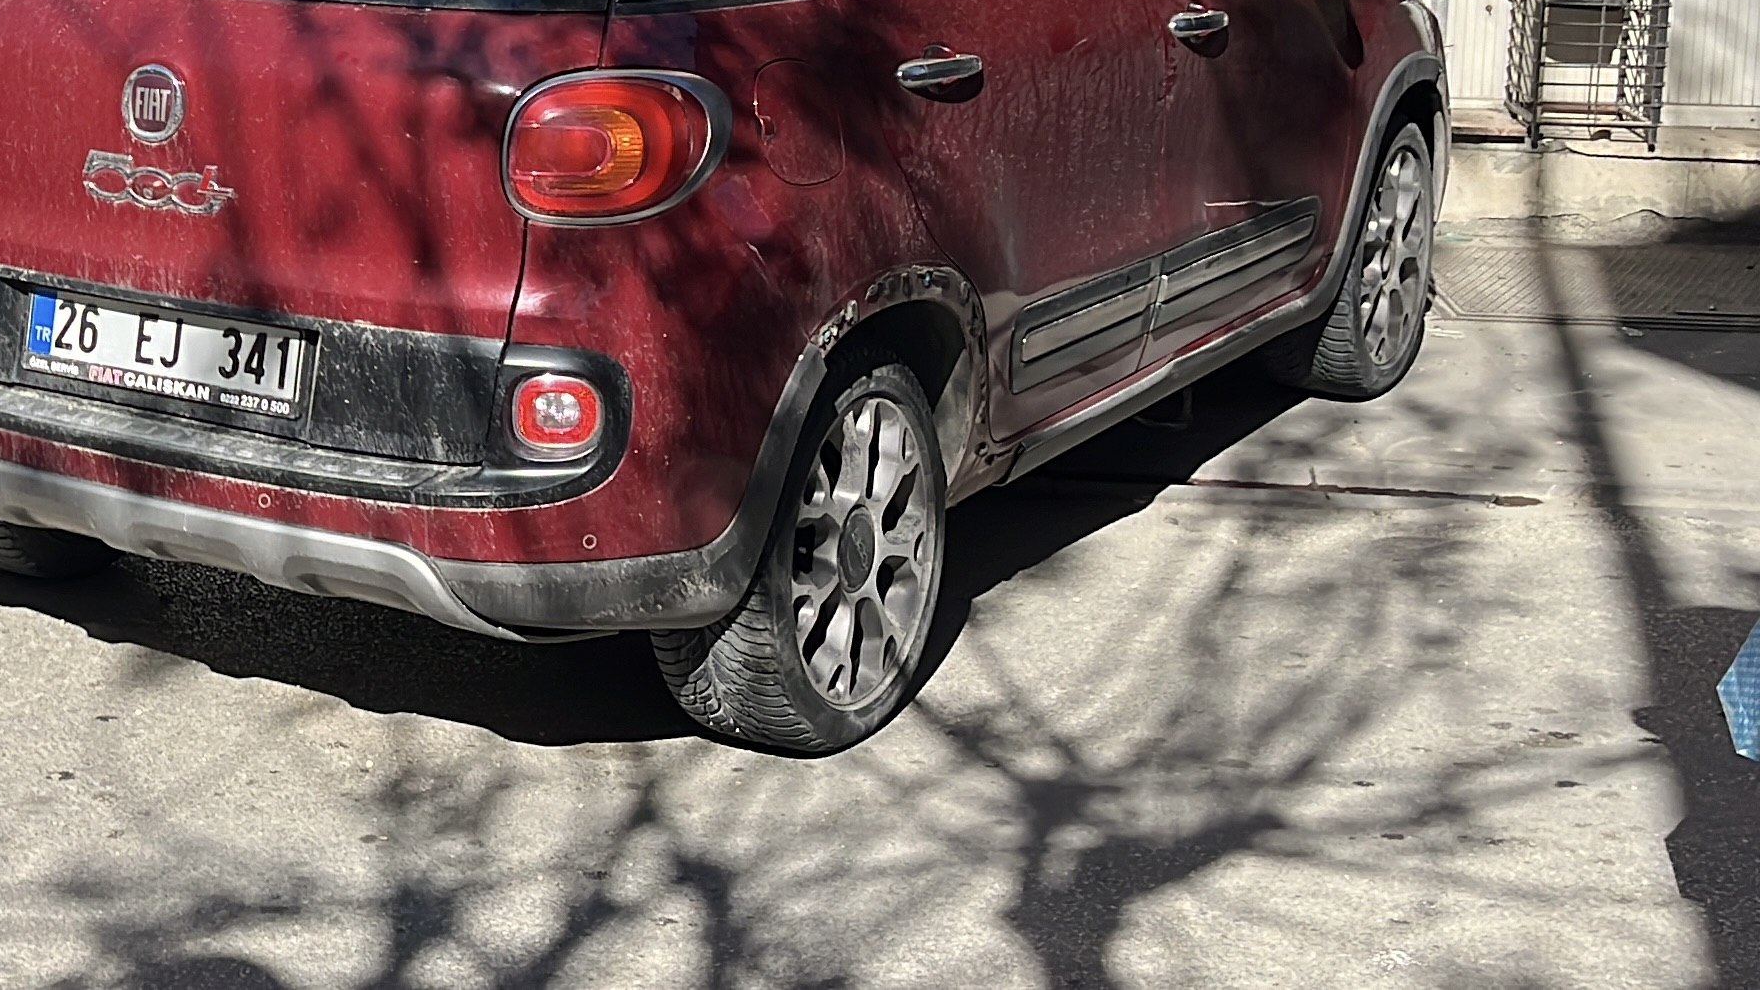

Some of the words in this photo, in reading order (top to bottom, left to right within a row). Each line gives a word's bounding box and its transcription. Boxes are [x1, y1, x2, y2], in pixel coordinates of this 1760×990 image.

[134, 86, 172, 123] FIAT
[34, 324, 52, 343] TR
[54, 299, 100, 354] 26
[134, 312, 184, 368] EJ
[218, 326, 290, 390] 341
[88, 364, 124, 386] FIAT
[240, 394, 260, 409] 237
[270, 400, 290, 415] 500
